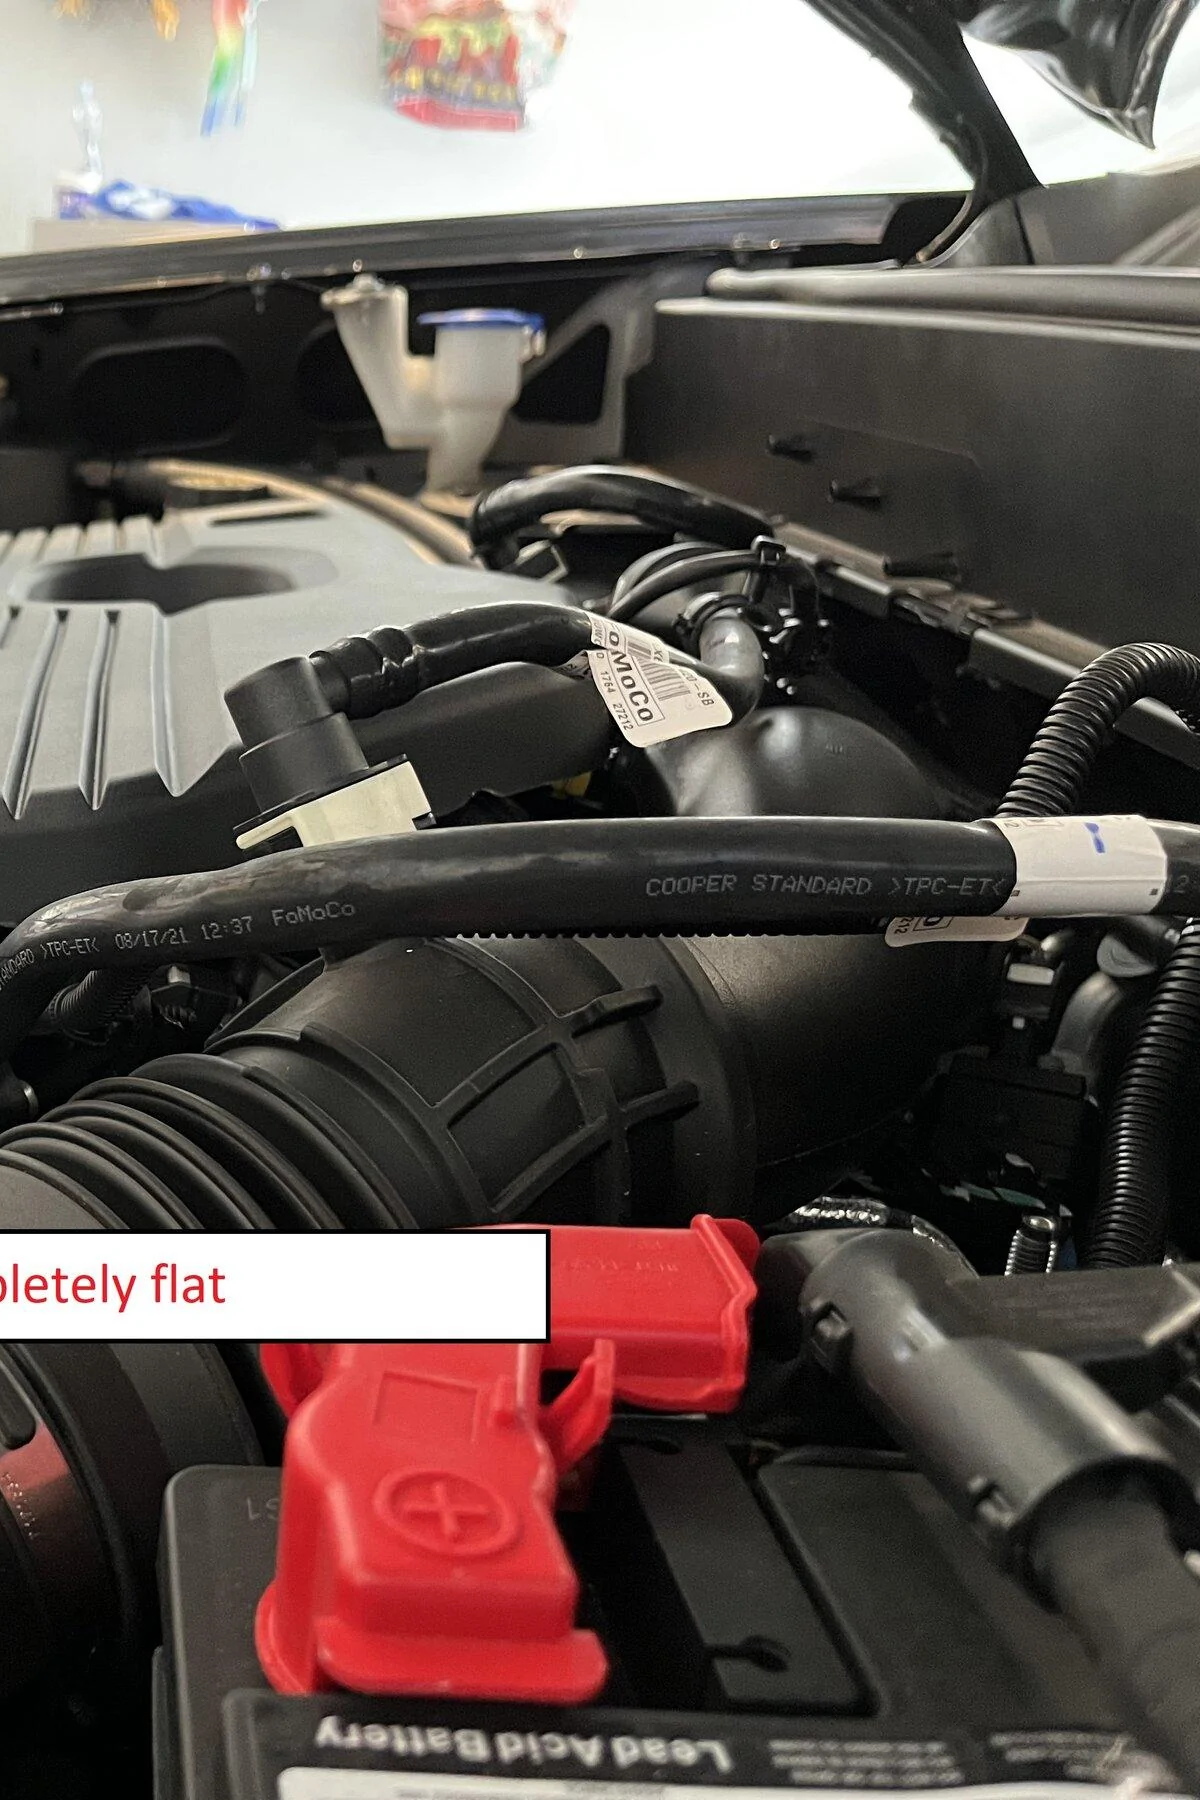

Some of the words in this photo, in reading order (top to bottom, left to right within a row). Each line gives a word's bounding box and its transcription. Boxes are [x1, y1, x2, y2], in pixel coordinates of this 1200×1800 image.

[645, 875, 738, 897] COOPER
[752, 874, 873, 897] STANDARD
[115, 927, 189, 950] 08/17/21
[200, 915, 253, 941] 12:37
[271, 901, 356, 927] FoMoCo
[315, 1714, 491, 1764] Battery
[494, 1731, 602, 1767] Acid
[611, 1735, 732, 1773] Lead
